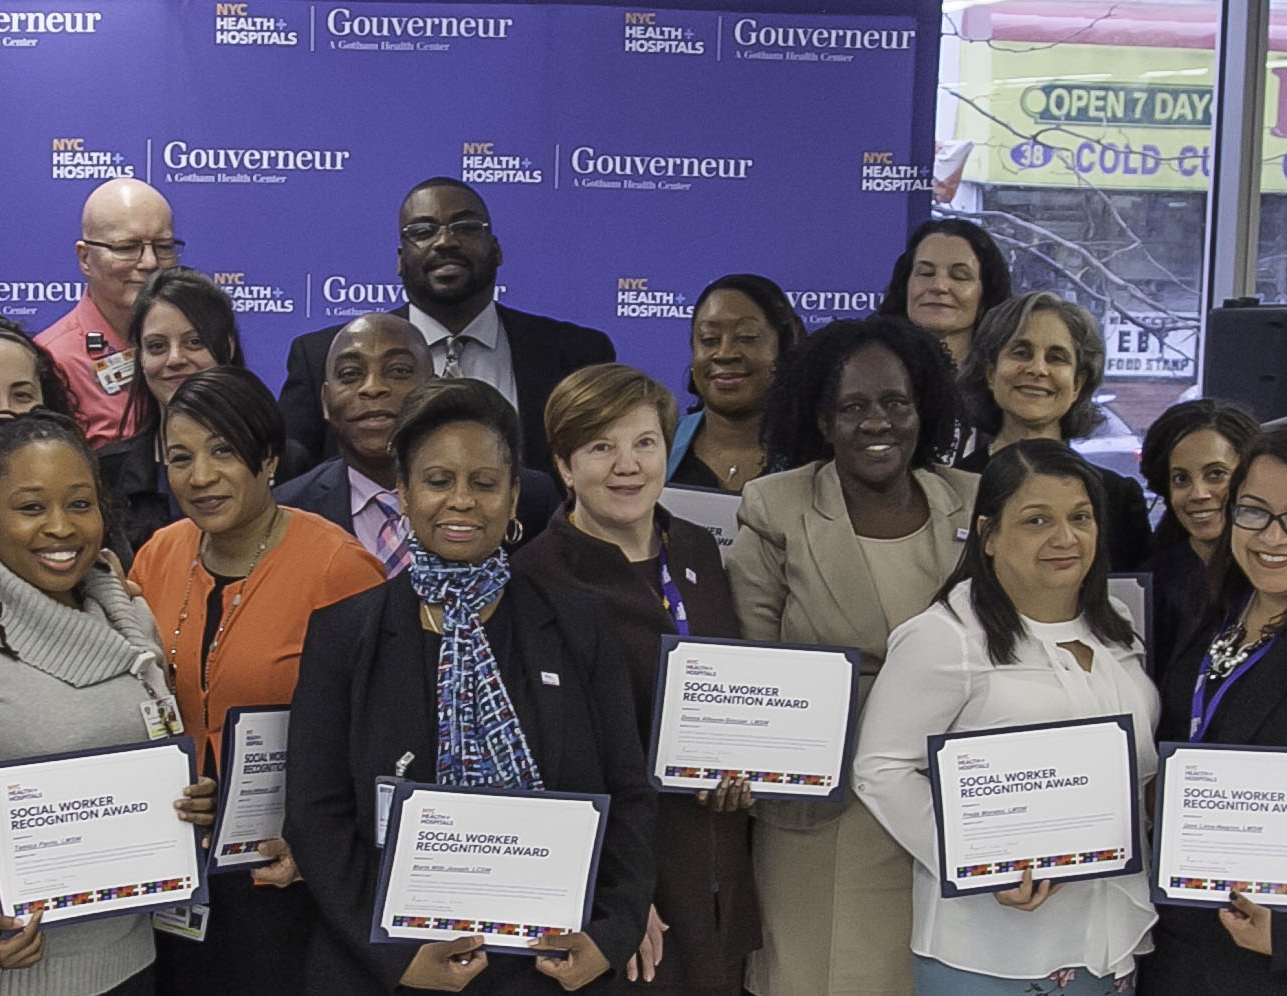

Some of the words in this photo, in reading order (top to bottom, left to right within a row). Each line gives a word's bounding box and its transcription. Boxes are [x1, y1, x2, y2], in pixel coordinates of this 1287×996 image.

[216, 3, 248, 15] NYC
[327, 8, 513, 38] Gouverneur
[625, 13, 656, 25] NYC
[216, 32, 298, 46] HOSPITALS
[733, 18, 916, 49] Gouverneur
[2, 38, 38, 47] Center
[338, 41, 379, 50] Gotham
[380, 41, 414, 51] Health
[416, 42, 451, 51] Center
[624, 40, 705, 54] HOSPITALS
[744, 51, 784, 61] Gotham
[785, 52, 819, 62] Health
[820, 53, 854, 63] Center
[1049, 88, 1125, 118] OPEN
[1133, 93, 1147, 118] 7
[53, 139, 84, 150] NYC
[463, 143, 494, 155] NYC
[164, 141, 350, 171] Gouverneur
[864, 153, 894, 164] NYC
[1020, 144, 1044, 165] 38
[1075, 140, 1161, 175] COLD
[571, 147, 753, 178] Gouverneur
[52, 166, 134, 179] HOSPITALS
[175, 173, 216, 183] Gotham
[217, 173, 251, 183] Health
[252, 174, 287, 184] Center
[463, 170, 542, 183] HOSPITALS
[582, 179, 622, 188] Gotham
[623, 180, 657, 189] Health
[658, 181, 692, 190] Center
[214, 273, 245, 284] NYC
[617, 279, 648, 291] NYC
[3, 306, 38, 315] Center
[684, 682, 726, 693] SOCIAL
[729, 685, 779, 697] WORKER
[683, 693, 763, 706] RECOGNITION
[766, 698, 809, 709] AWARD
[959, 774, 1003, 787] SOCIAL
[1005, 769, 1057, 781] WORKER
[960, 781, 1043, 798] RECOGNITION
[1046, 776, 1089, 789] AWARD
[1184, 788, 1227, 799] SOCIAL
[1231, 791, 1285, 801] WORKER
[10, 805, 55, 819] SOCIAL
[58, 796, 114, 812] WORKER
[1183, 798, 1269, 812] RECOGNITION
[11, 810, 99, 830] RECOGNITION
[102, 802, 148, 818] AWARD
[418, 831, 462, 842] SOCIAL
[465, 834, 519, 844] WORKER
[416, 842, 500, 855] RECOGNITION
[504, 846, 549, 857] AWARD
